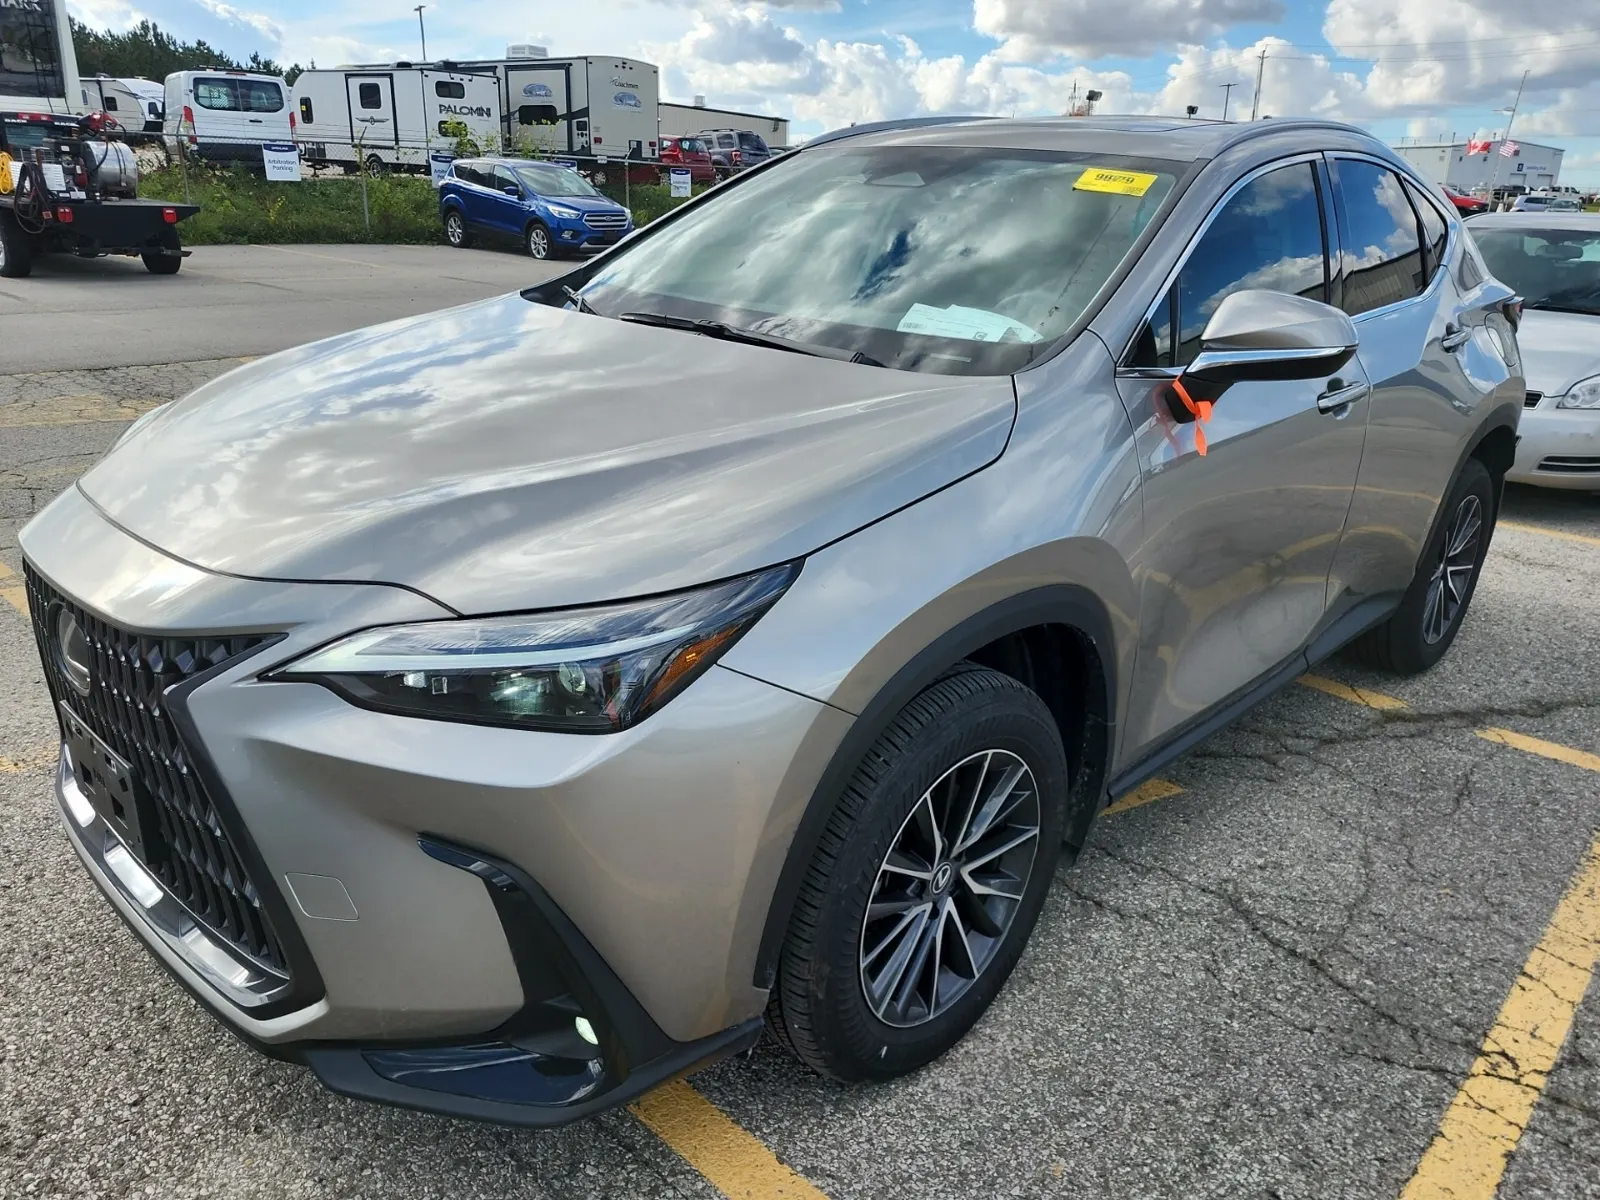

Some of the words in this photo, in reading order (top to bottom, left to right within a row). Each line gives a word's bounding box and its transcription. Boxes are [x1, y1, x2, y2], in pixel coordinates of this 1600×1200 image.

[438, 103, 492, 119] PALOMINI
[268, 158, 297, 166] Arbitration
[272, 165, 294, 173] Parking
